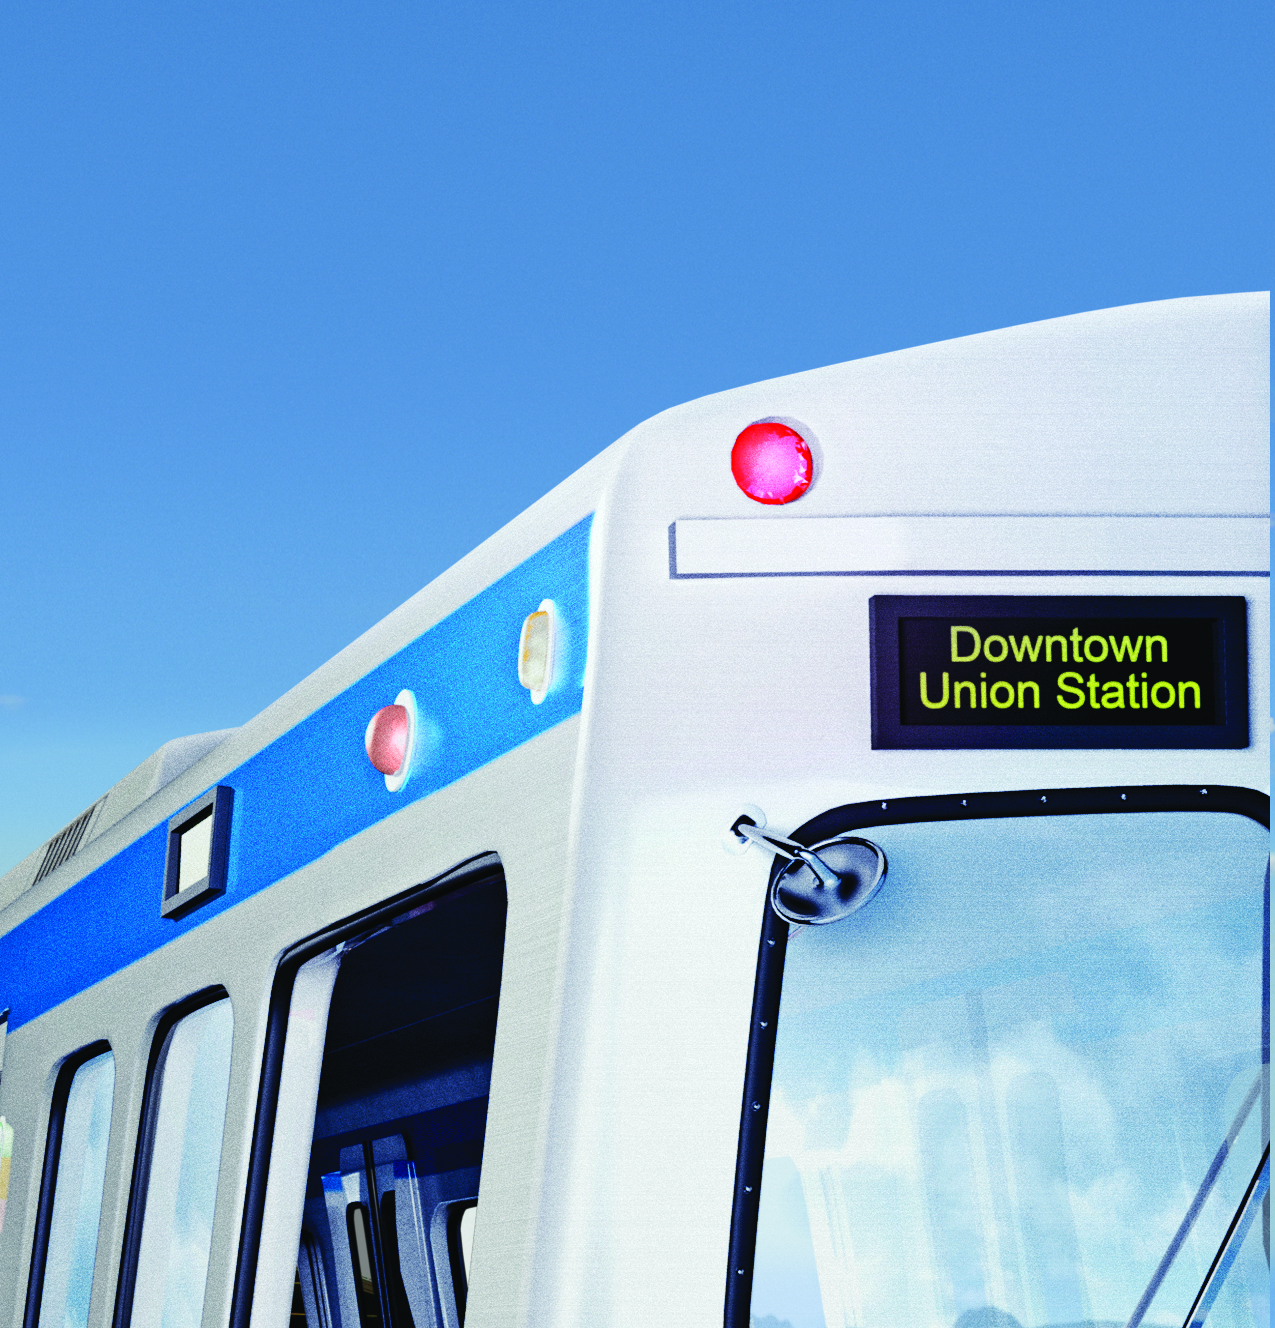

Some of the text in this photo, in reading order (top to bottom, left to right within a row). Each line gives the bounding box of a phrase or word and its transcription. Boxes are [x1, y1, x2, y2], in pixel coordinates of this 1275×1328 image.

[950, 625, 1168, 663] Downtown
[919, 671, 1201, 710] Union Station
